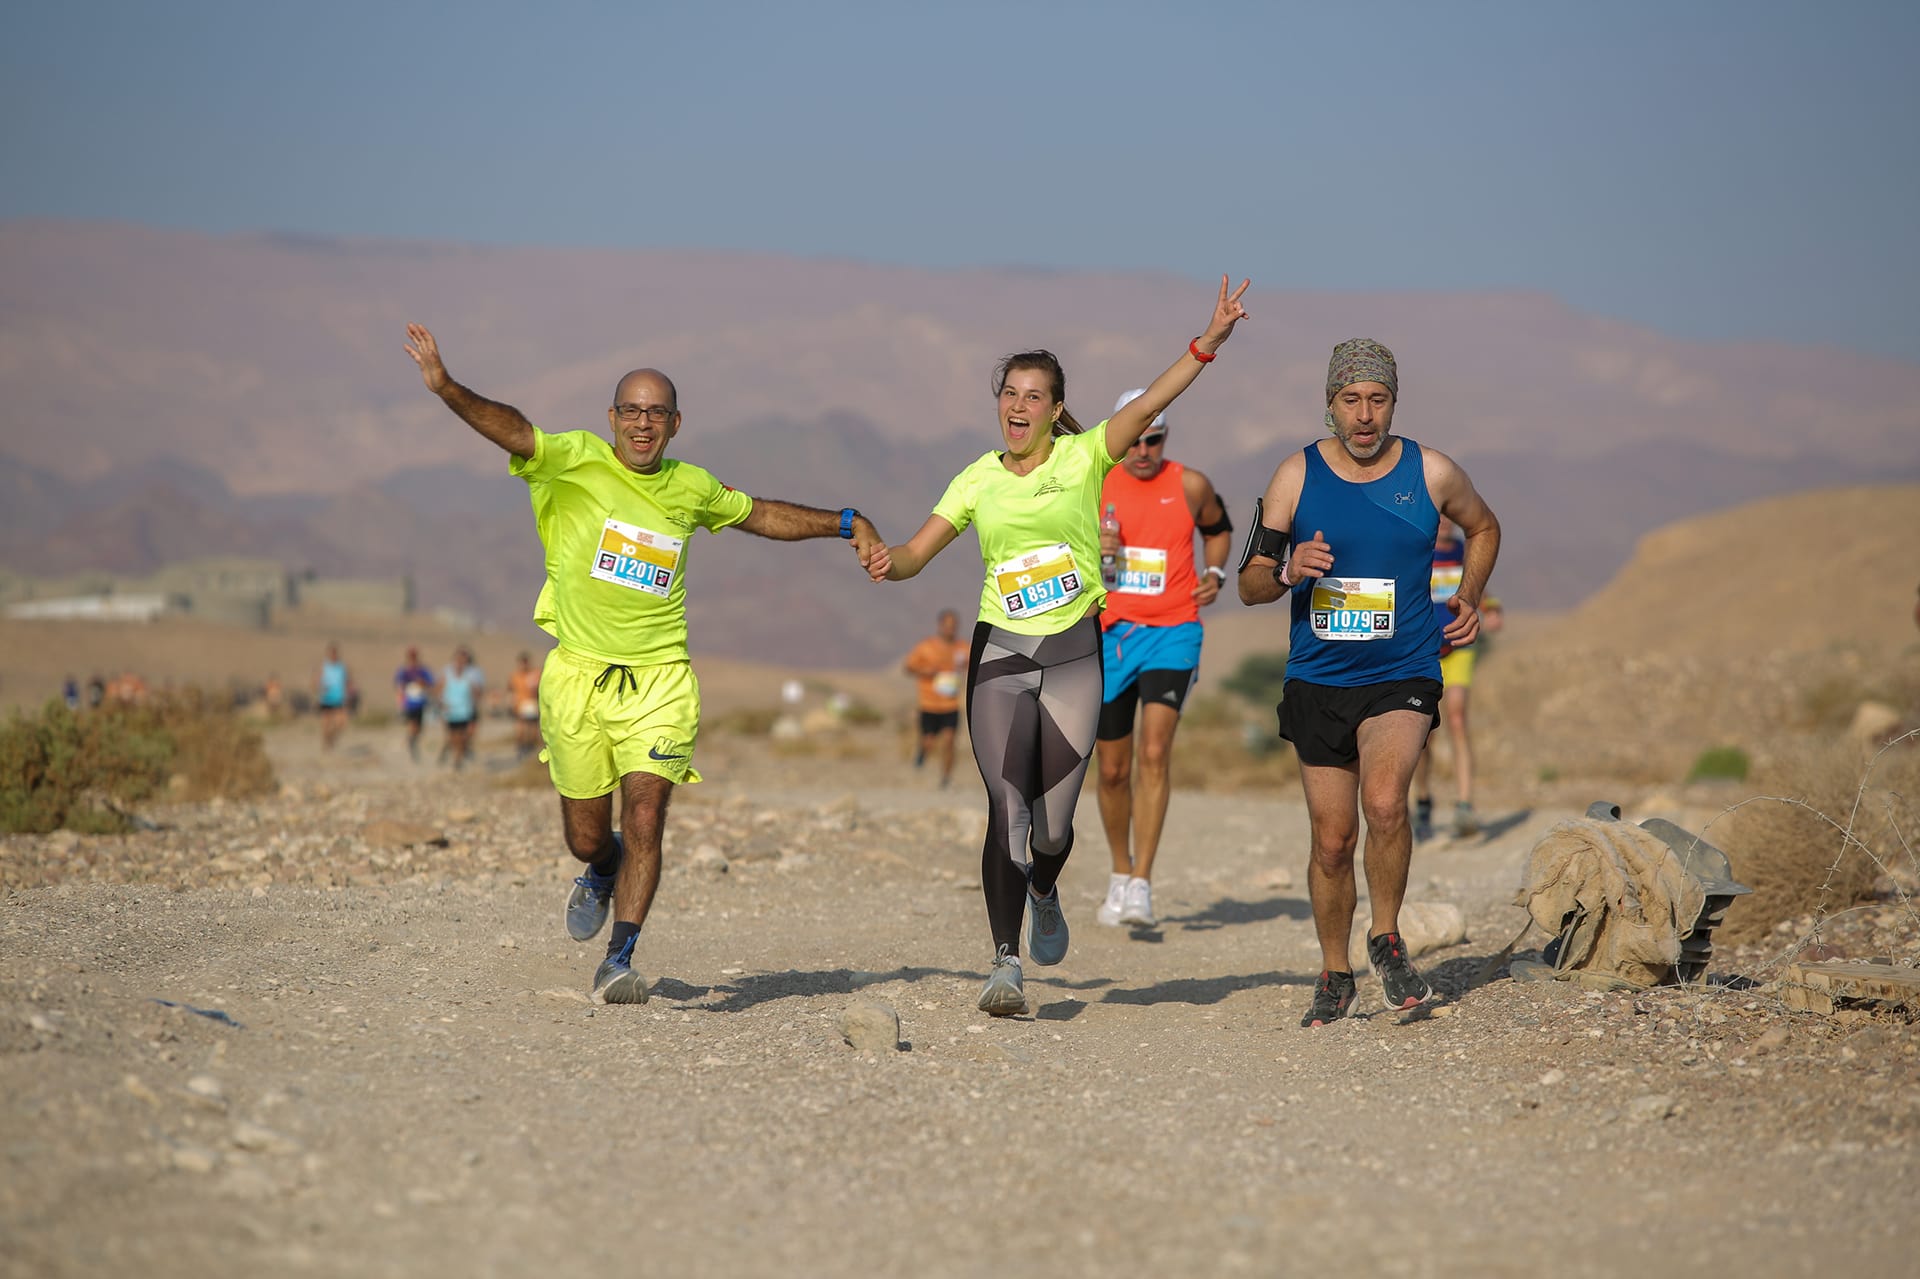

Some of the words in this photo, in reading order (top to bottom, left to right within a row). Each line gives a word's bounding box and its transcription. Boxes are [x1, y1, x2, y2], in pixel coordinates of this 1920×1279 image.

[621, 542, 636, 555] 10
[619, 557, 655, 581] 1201
[1015, 574, 1031, 587] 10
[1026, 579, 1055, 602] 857
[1333, 611, 1370, 627] 1079
